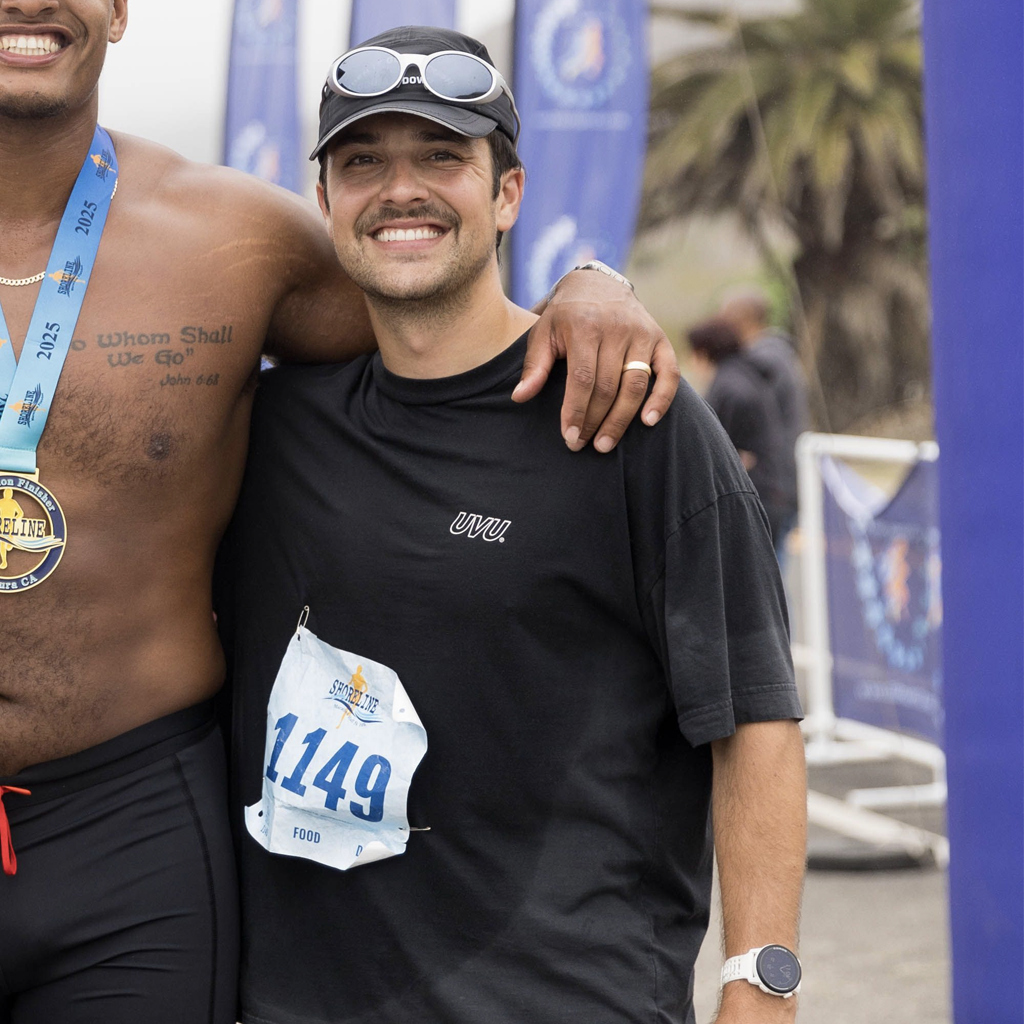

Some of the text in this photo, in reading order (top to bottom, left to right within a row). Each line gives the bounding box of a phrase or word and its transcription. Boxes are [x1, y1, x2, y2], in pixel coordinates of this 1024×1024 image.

[74, 200, 98, 236] 2025
[36, 321, 61, 361] 2025
[71, 325, 233, 351] o Whom Shall
[107, 352, 144, 368] We
[17, 479, 56, 512] Finisher
[21, 576, 38, 587] CA
[328, 679, 379, 714] SHORELINE
[266, 712, 392, 822] 1149
[293, 827, 321, 844] FOOD
